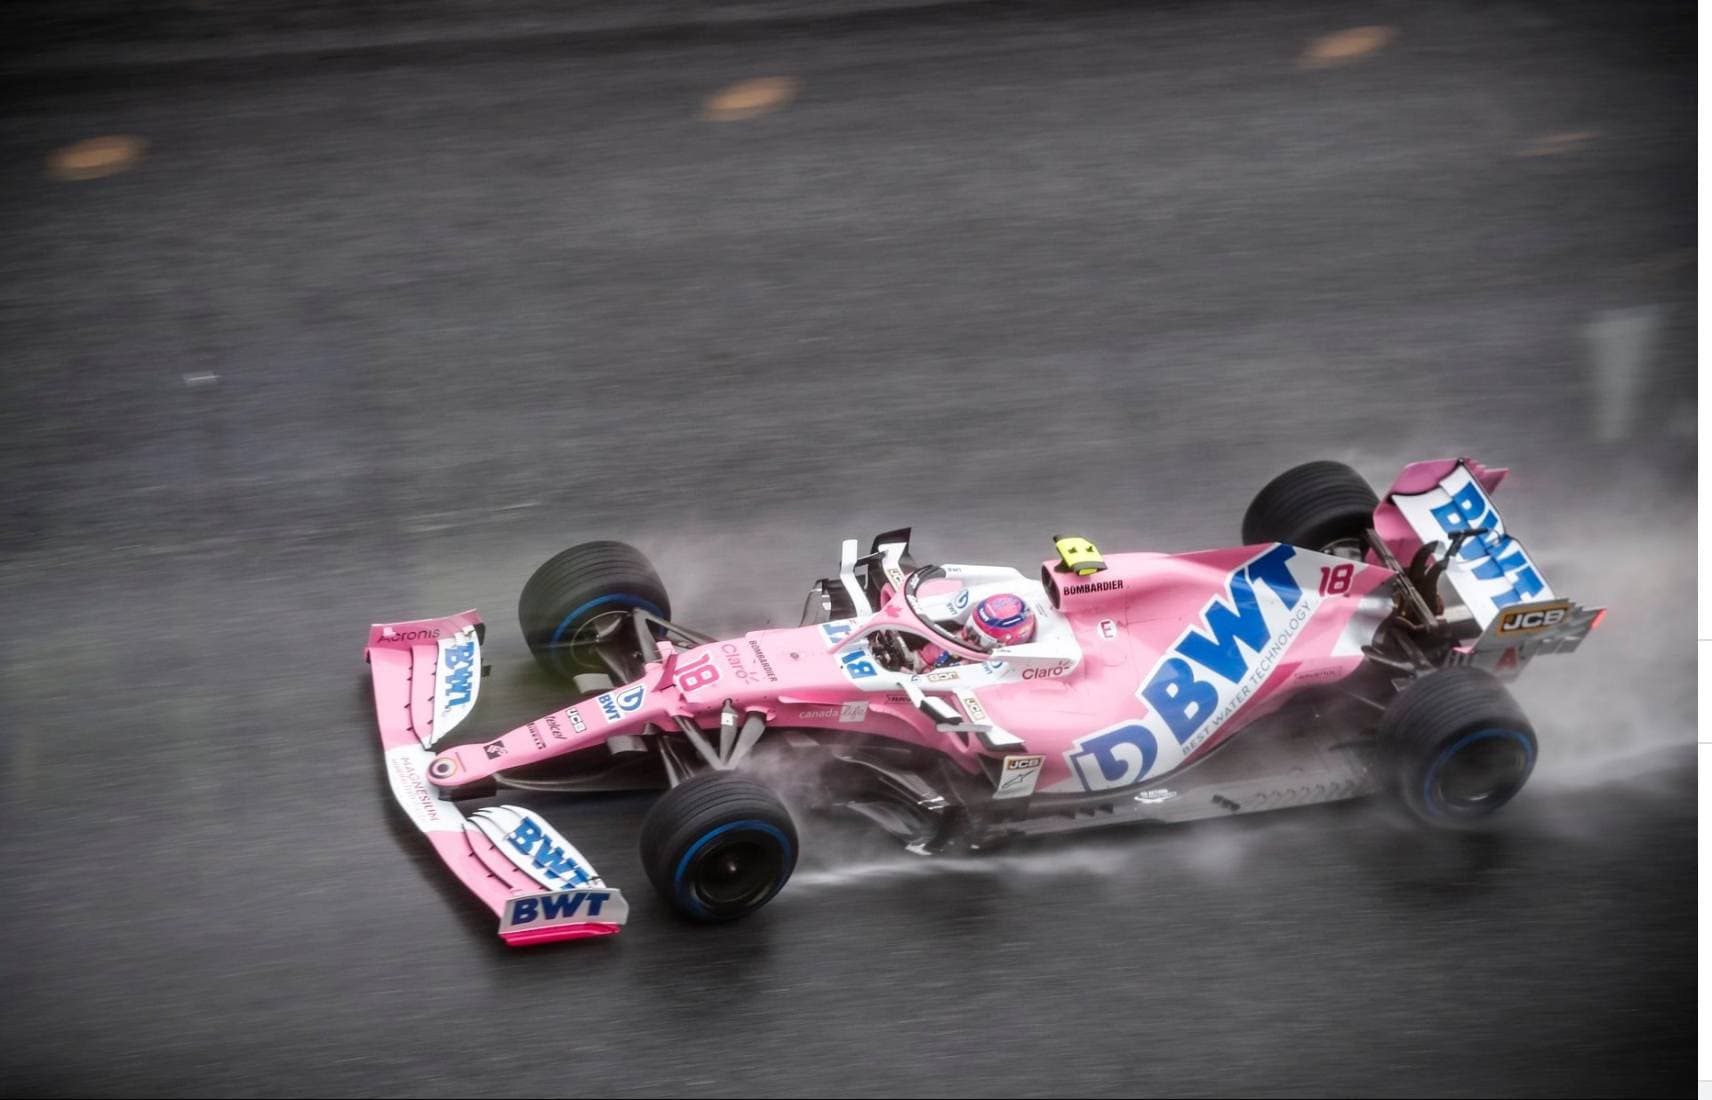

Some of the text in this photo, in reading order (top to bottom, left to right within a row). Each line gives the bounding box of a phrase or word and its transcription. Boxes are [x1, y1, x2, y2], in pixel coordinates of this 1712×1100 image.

[1430, 480, 1545, 609] BWT
[1063, 579, 1124, 596] BOMBARDIER
[1319, 563, 1354, 598] 18
[1101, 620, 1114, 639] E
[1502, 609, 1565, 630] JCB
[721, 643, 749, 680] Claro
[748, 639, 779, 683] BOMBARDIER
[1141, 543, 1302, 746] BWT
[673, 653, 721, 692] 18
[1022, 663, 1065, 680] Claro
[1182, 601, 1312, 756] BEST WATER TECHNOLOGY
[567, 707, 587, 733] JCB
[598, 693, 622, 721] BWT
[799, 708, 839, 720] canada
[400, 756, 441, 821] MAGNESIUM
[507, 815, 591, 889] BWT
[511, 892, 611, 926] BWT
